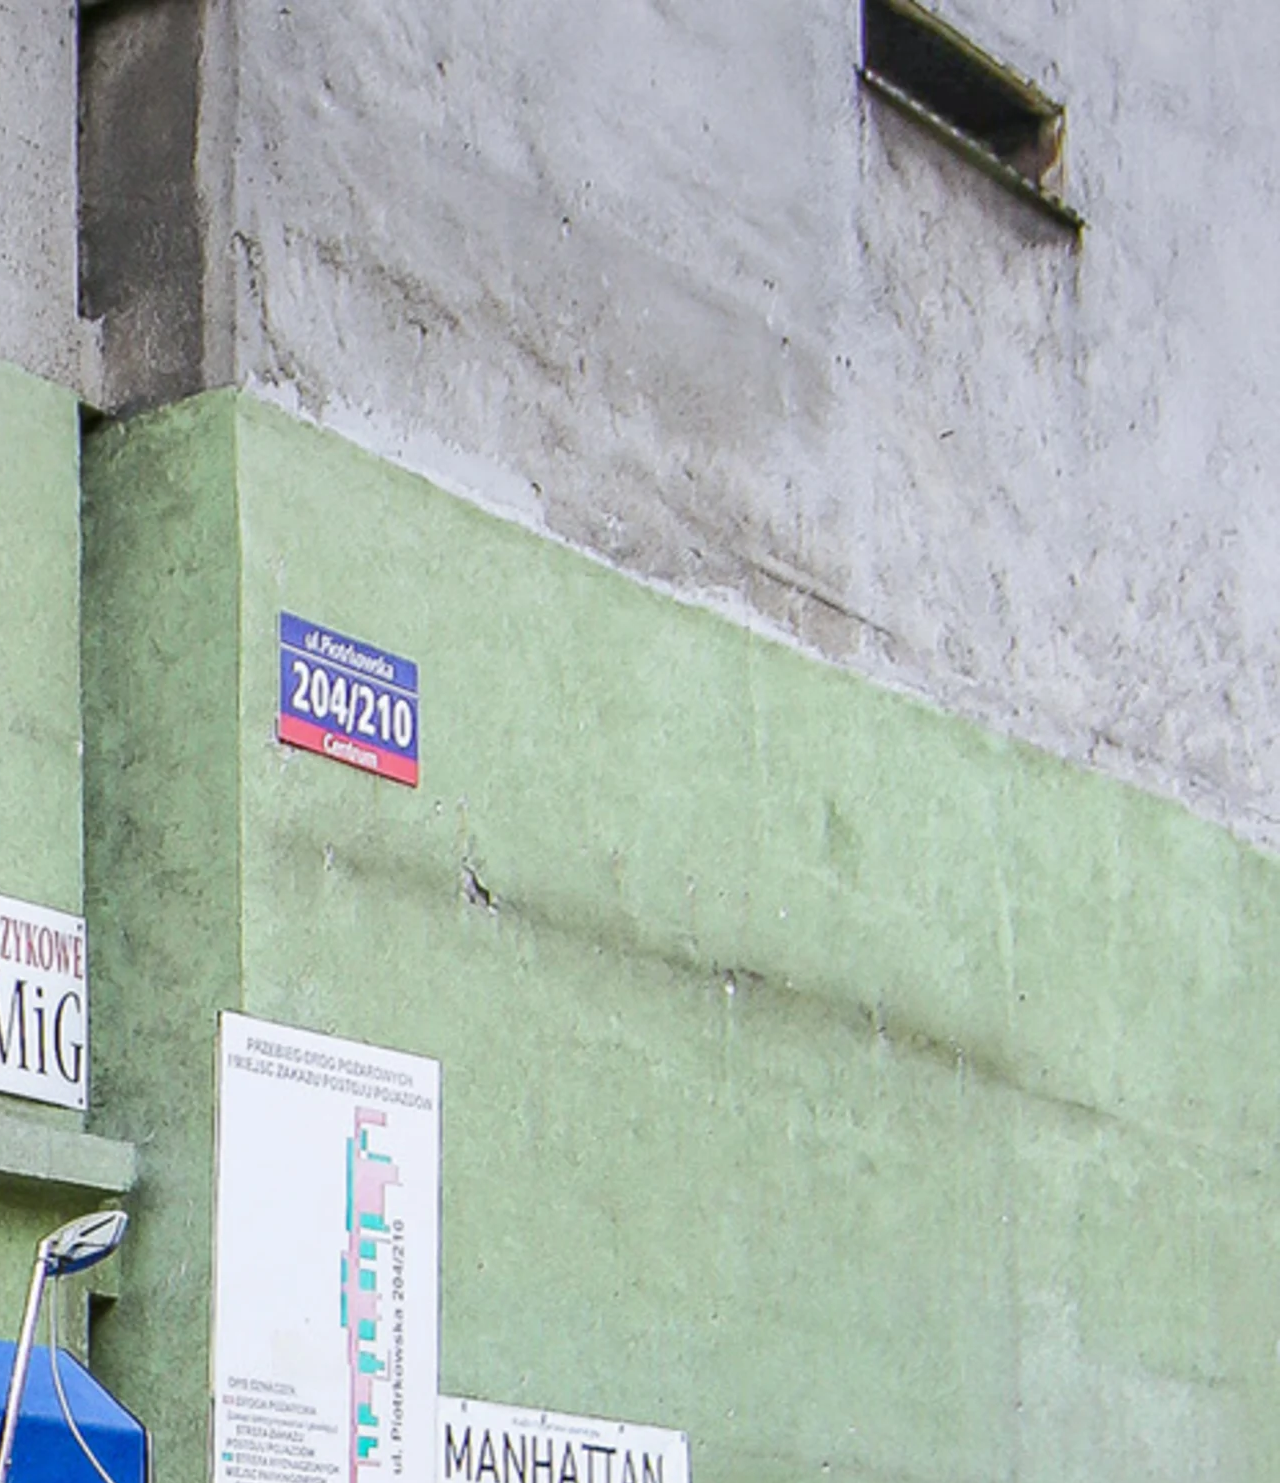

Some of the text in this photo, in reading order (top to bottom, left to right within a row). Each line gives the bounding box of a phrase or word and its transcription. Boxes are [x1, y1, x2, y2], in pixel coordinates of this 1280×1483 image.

[292, 660, 412, 748] 204/210
[323, 733, 379, 768] Centrum
[276, 1063, 320, 1088] ZAKAZU
[323, 1073, 372, 1098] POSTOJU
[391, 1218, 405, 1302] 204/210
[391, 1308, 404, 1442] Piotrkowska
